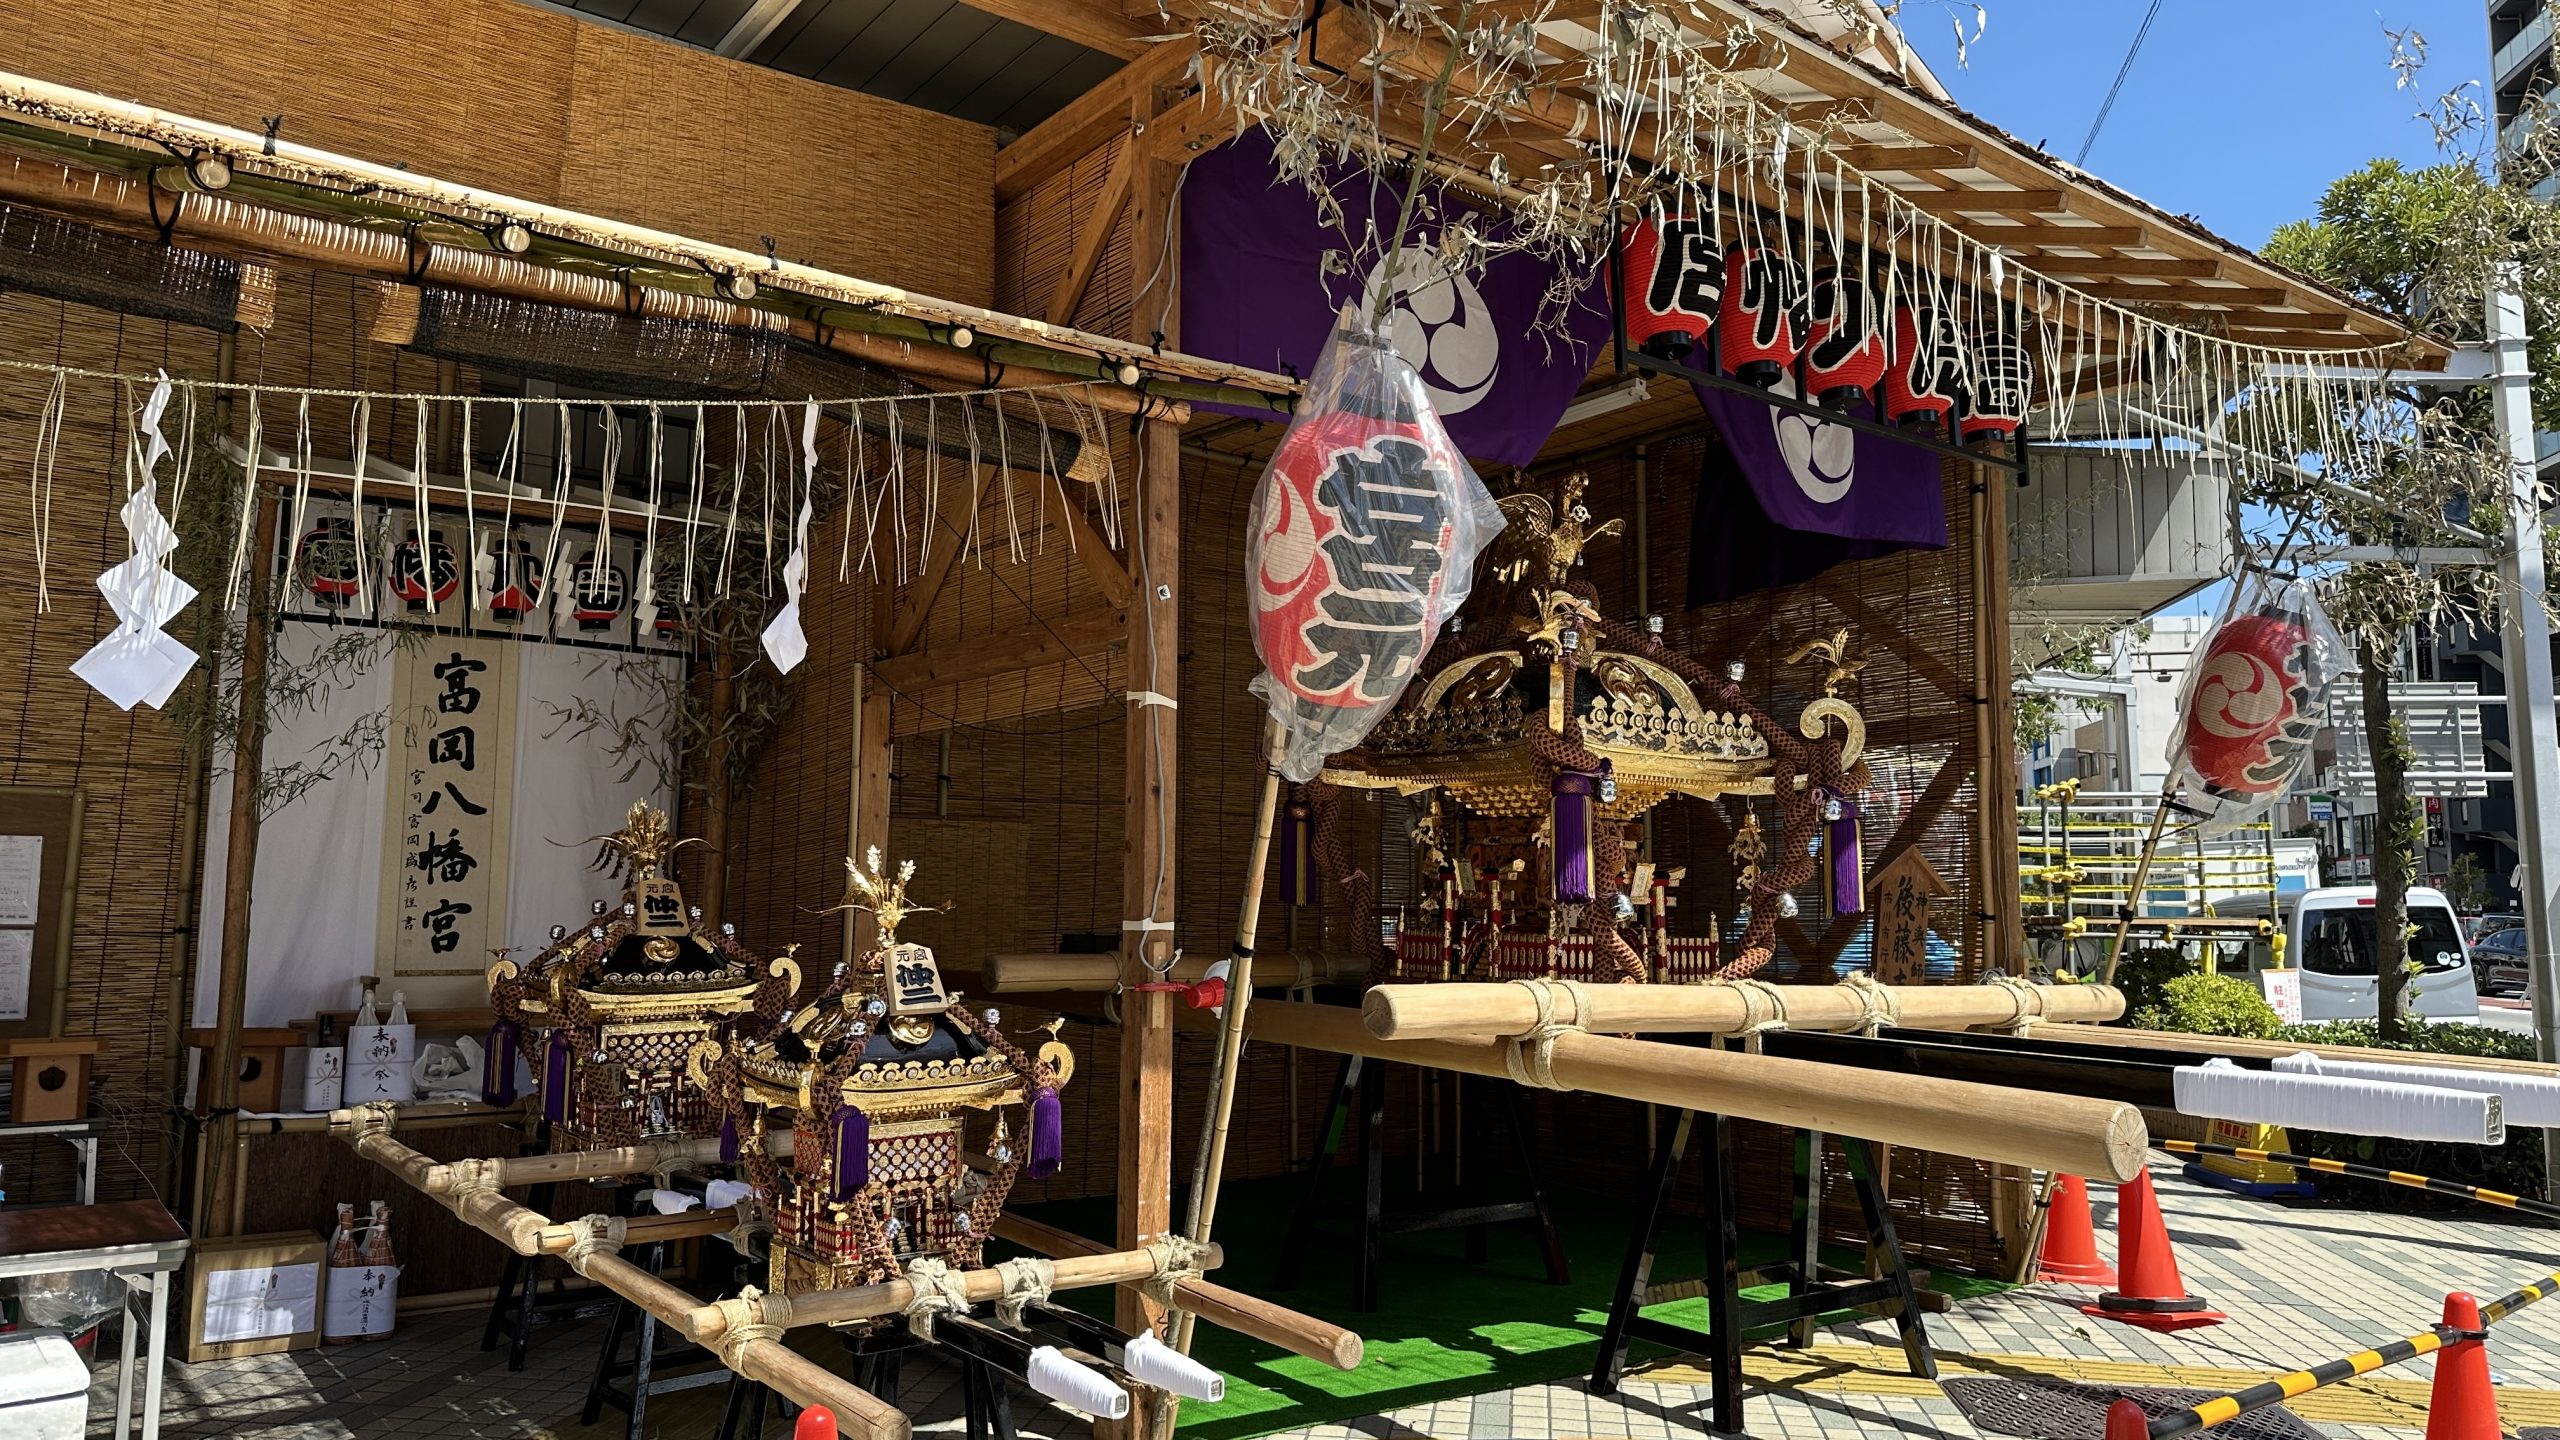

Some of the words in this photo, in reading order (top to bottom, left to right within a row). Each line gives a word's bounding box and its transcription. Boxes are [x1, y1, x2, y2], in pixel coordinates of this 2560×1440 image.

[419, 652, 487, 954] 富岡八幡宮
[372, 1027, 390, 1058] 奉納
[360, 1269, 375, 1298] 奉納
